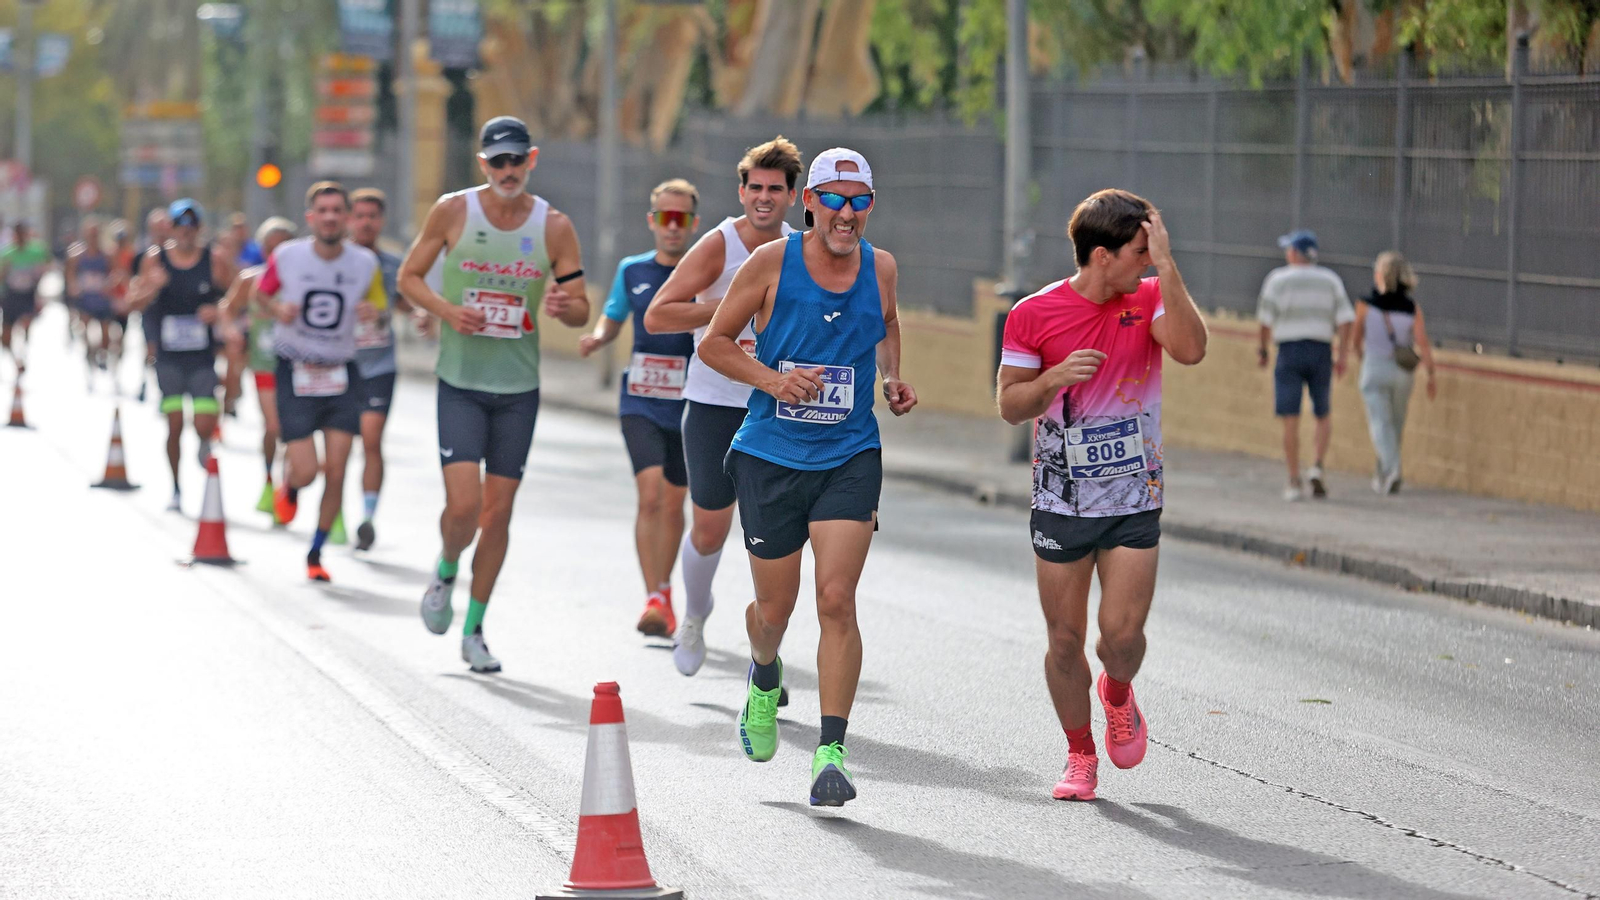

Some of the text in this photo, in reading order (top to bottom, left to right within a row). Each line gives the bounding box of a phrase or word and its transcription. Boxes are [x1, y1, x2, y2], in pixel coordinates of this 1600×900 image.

[481, 306, 509, 322] 73
[1086, 441, 1126, 463] 808
[1098, 461, 1141, 476] MIZUNO
